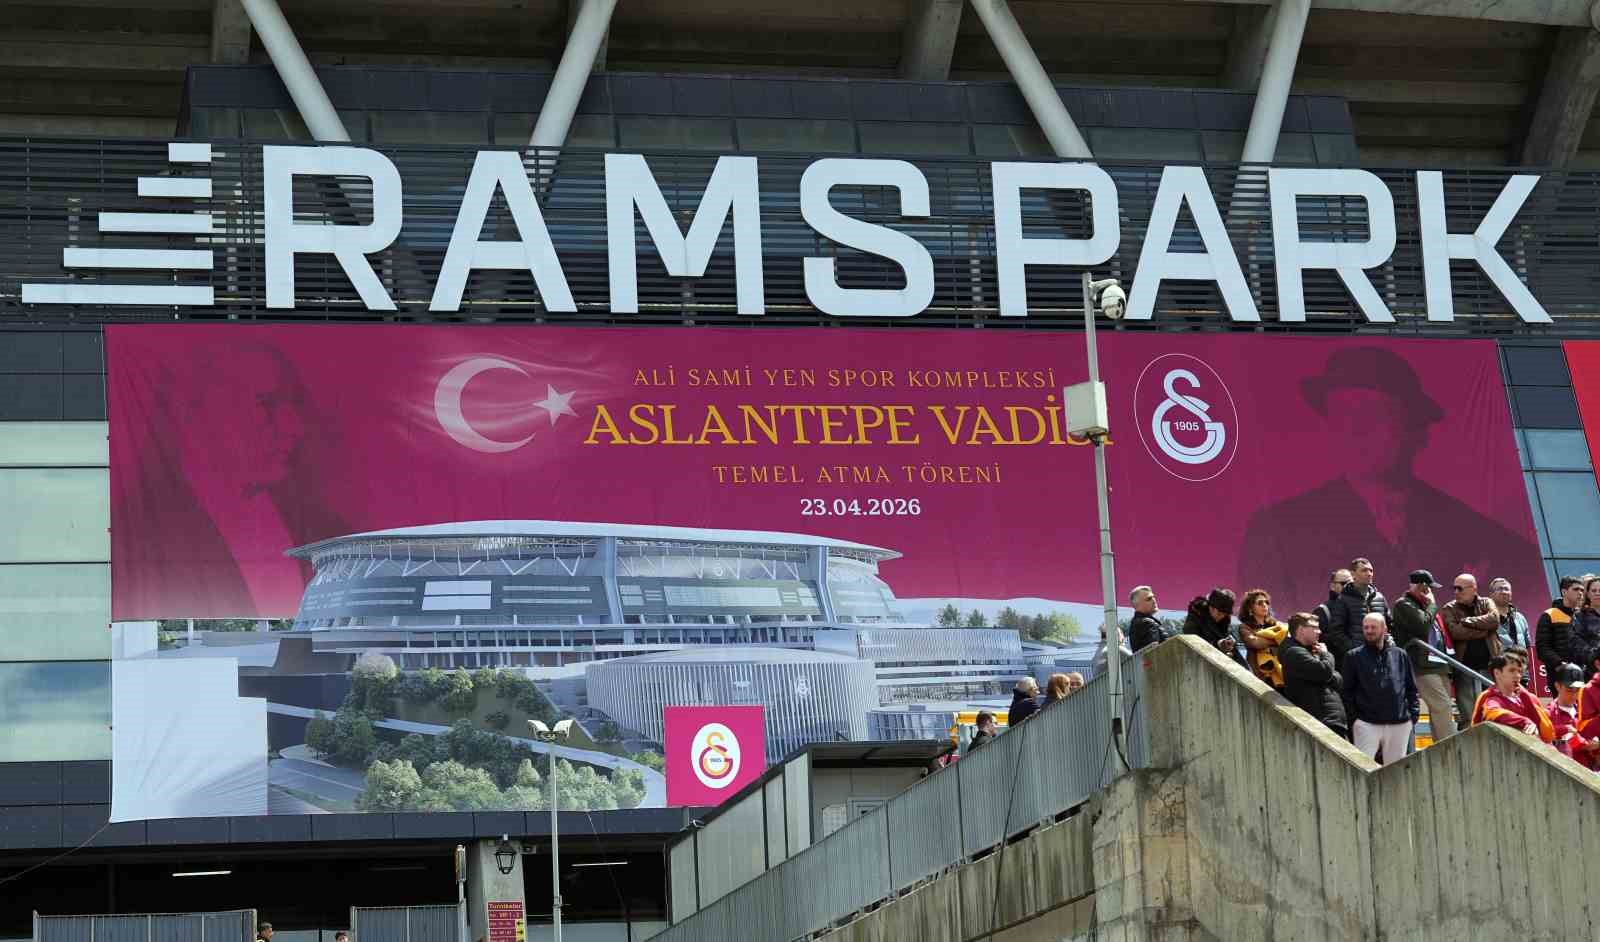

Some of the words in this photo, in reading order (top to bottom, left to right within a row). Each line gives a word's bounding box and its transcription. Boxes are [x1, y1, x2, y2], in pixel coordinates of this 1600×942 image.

[633, 365, 676, 386] ALİ
[688, 365, 752, 387] SAMİ
[763, 369, 816, 387] YEN
[828, 369, 896, 388] SPOR
[908, 367, 1056, 389] KOMPLEKSİ
[584, 403, 920, 446] ASLANTEPE
[928, 395, 1114, 446] VADİ
[1173, 421, 1200, 432] 1905
[712, 466, 804, 483] TEMEL
[816, 466, 891, 483] ATMA
[902, 462, 1001, 484] TÖRENİ
[799, 498, 921, 516] 23.04.2026
